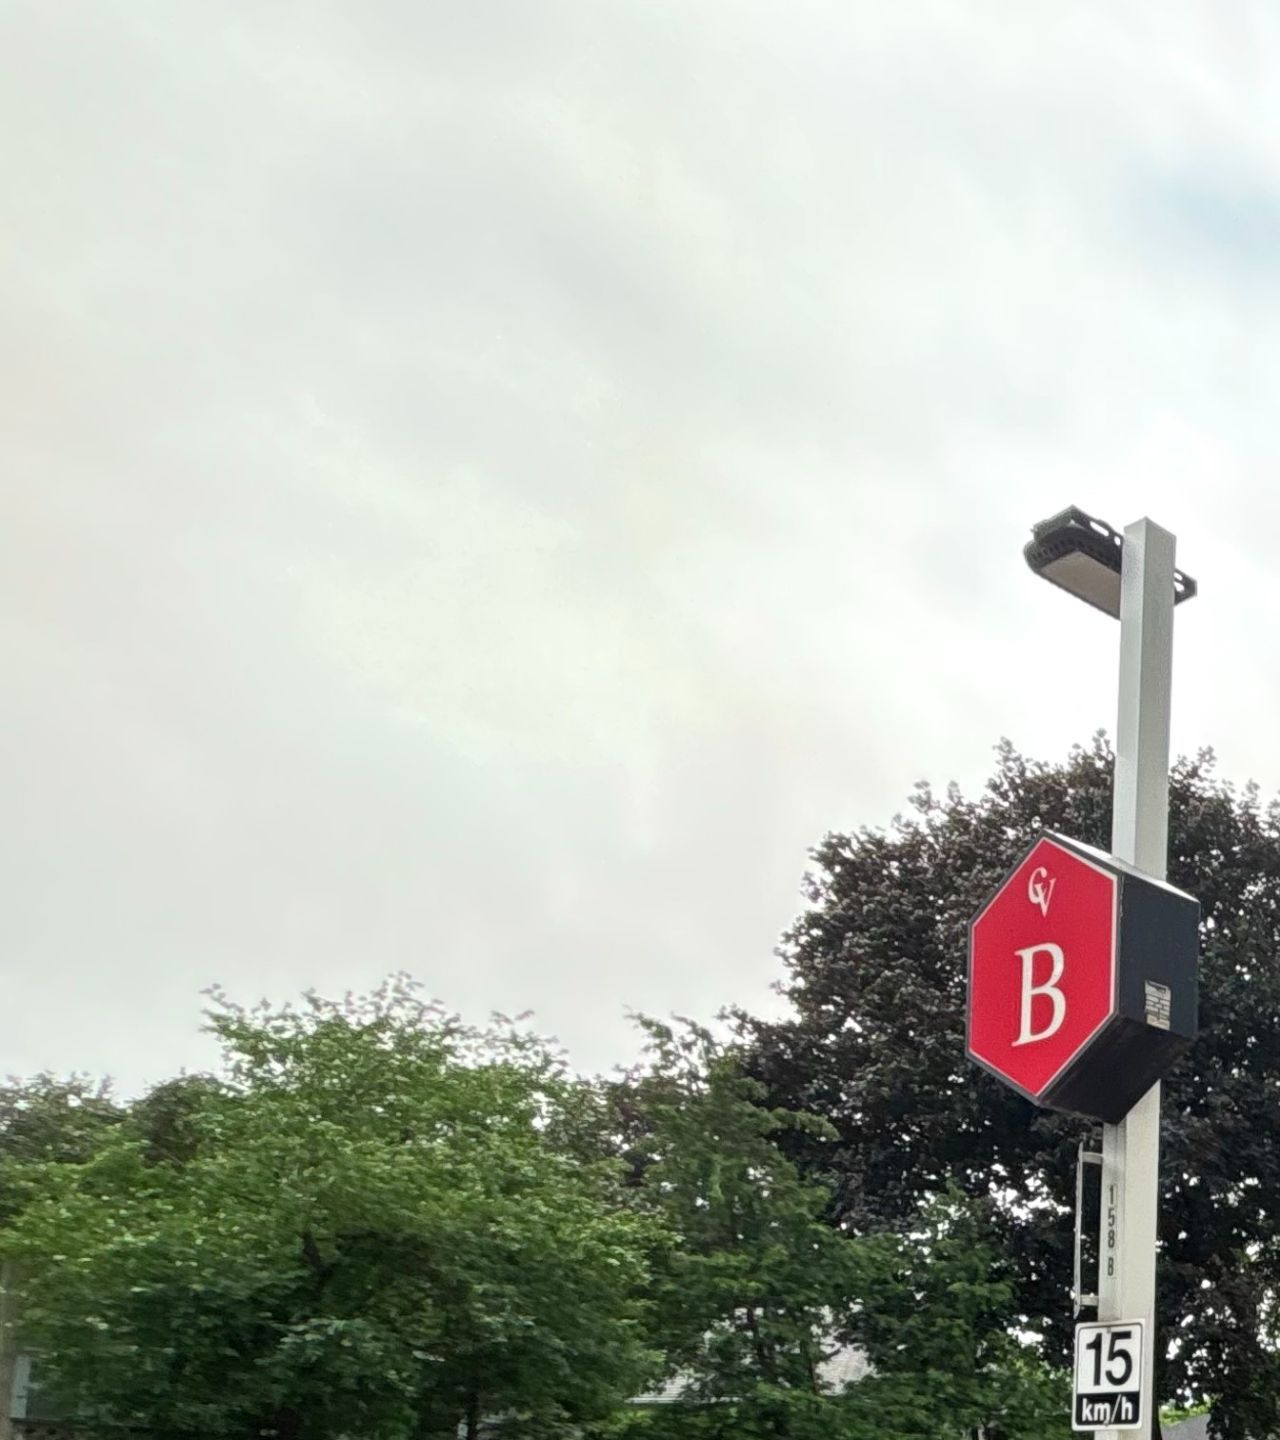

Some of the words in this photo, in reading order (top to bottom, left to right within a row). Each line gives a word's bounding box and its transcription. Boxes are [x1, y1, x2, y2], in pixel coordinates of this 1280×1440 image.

[1011, 942, 1066, 1048] B
[1086, 1331, 1133, 1387] 15
[1081, 1393, 1133, 1425] km/h
